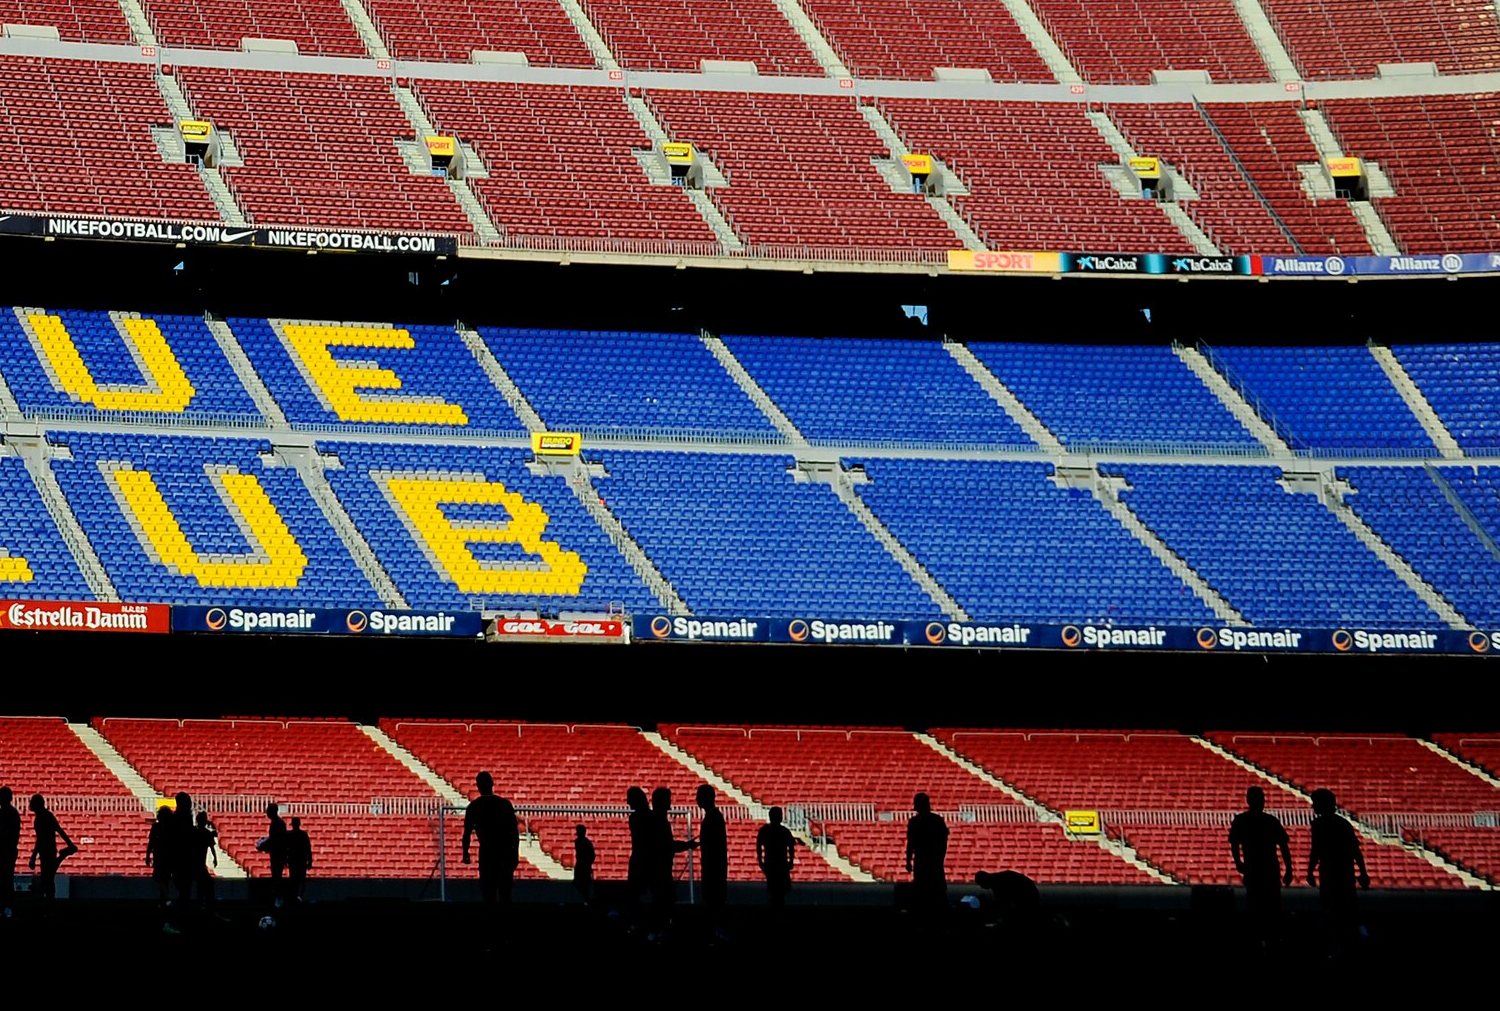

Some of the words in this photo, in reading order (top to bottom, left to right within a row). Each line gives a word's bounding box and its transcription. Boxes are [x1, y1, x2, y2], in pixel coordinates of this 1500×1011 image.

[142, 47, 155, 57] 433
[48, 218, 221, 243] NIKEFOOTBALL.COM
[267, 230, 436, 253] NIKEFOOTBALL.COM
[974, 253, 1034, 269] SPORT
[1274, 258, 1324, 272] Allianz
[1389, 256, 1440, 271] Allianz
[542, 437, 572, 446] MUNDO
[7, 602, 85, 628] Estrella
[84, 607, 148, 630] Damm
[229, 608, 316, 631] Spanair
[369, 611, 455, 634] Spanair
[503, 622, 546, 633] GOL
[563, 623, 606, 634] GOL
[673, 617, 757, 640] Spanair
[810, 619, 894, 643] Spanair
[947, 621, 1031, 645] Spanair
[1083, 625, 1167, 649] Spanair
[1218, 627, 1302, 651] Spanair
[1353, 630, 1438, 654] Spanair
